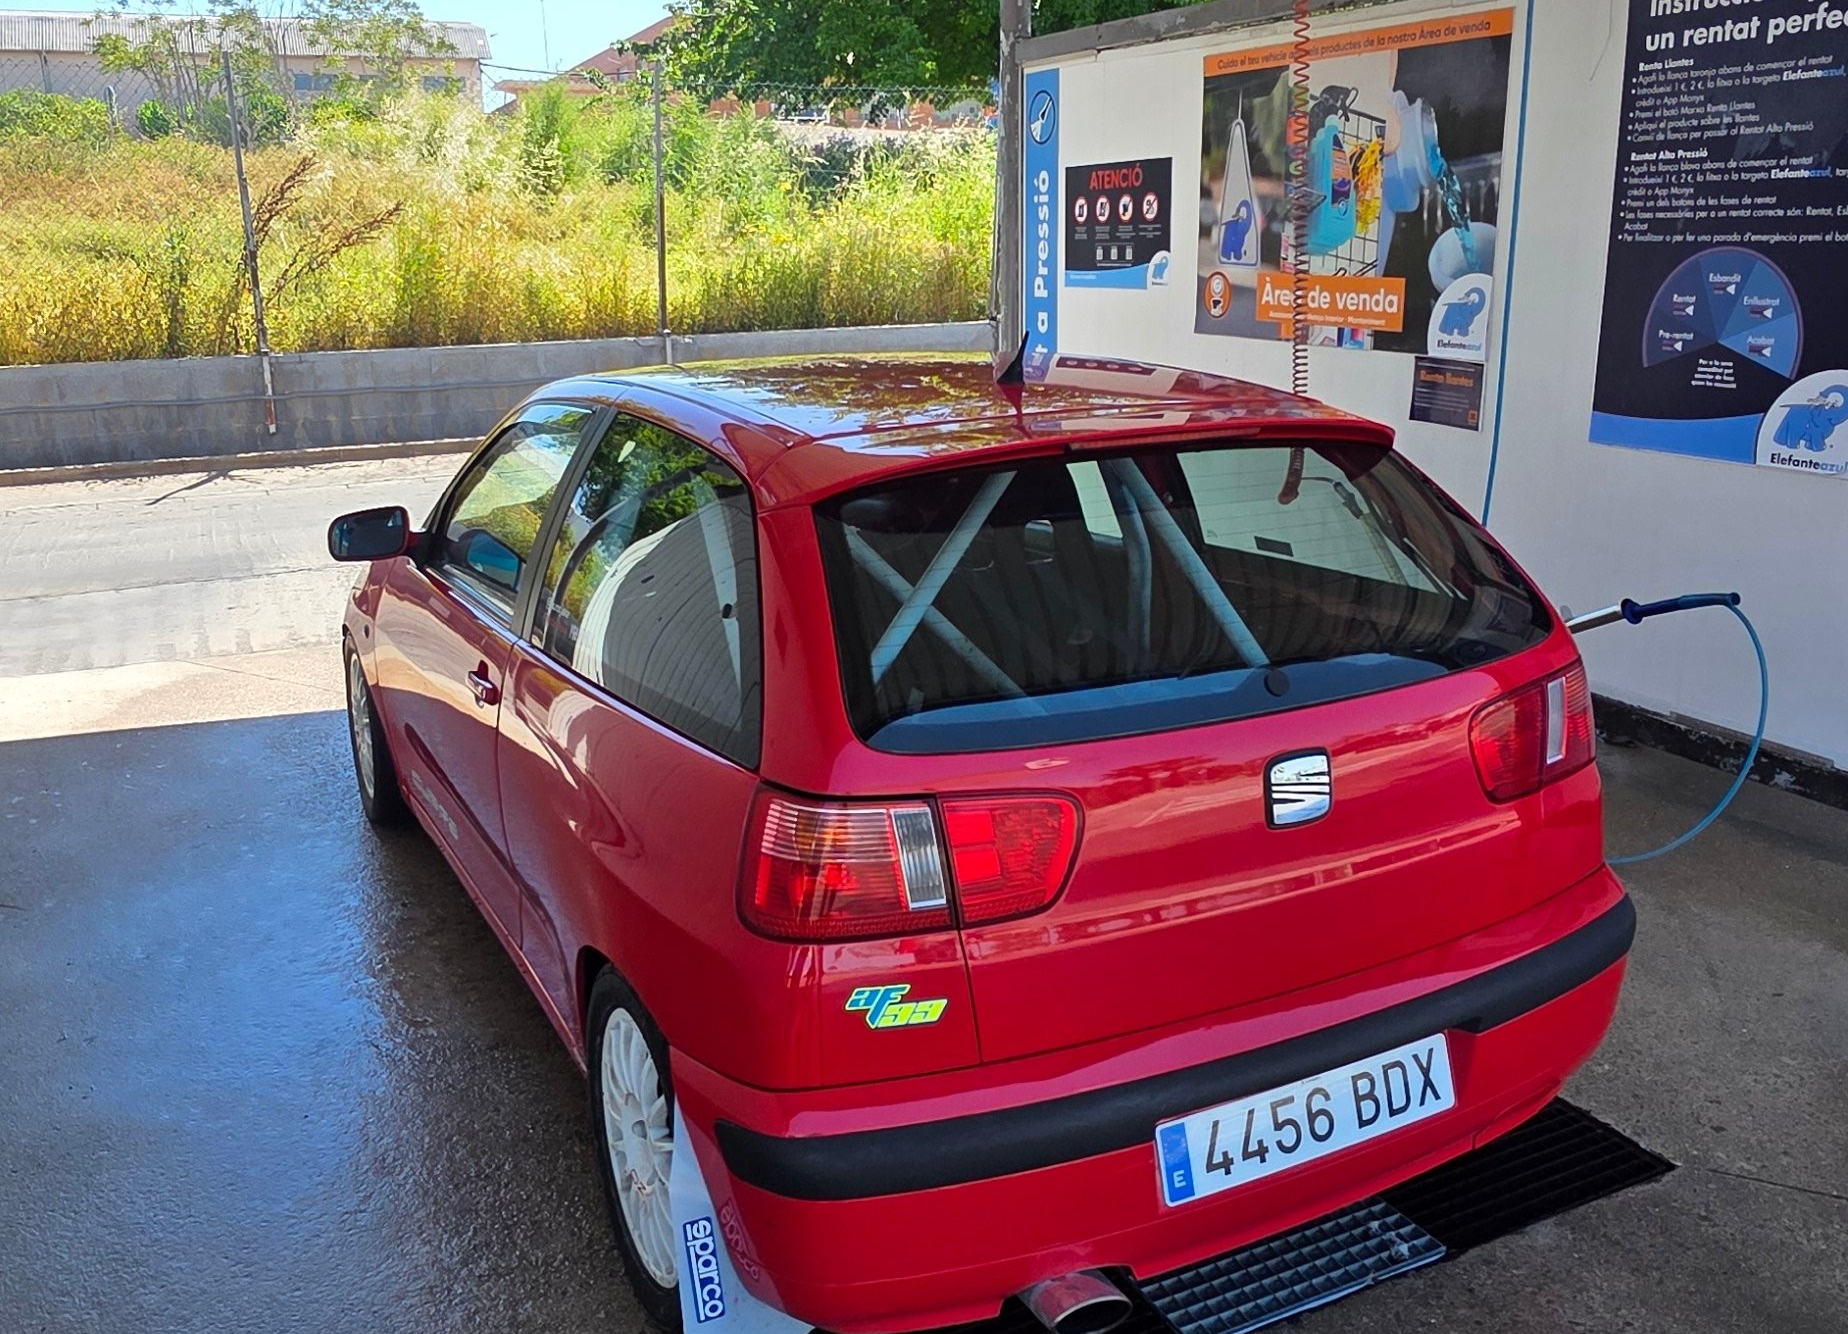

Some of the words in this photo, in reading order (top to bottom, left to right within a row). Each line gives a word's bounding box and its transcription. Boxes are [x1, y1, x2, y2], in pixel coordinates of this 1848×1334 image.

[1320, 40, 1361, 58] productes
[1363, 37, 1375, 48] de
[1376, 35, 1386, 46] la
[1387, 31, 1417, 45] nostra
[1443, 24, 1457, 36] de
[1459, 20, 1491, 34] venda
[1645, 31, 1675, 51] un
[1682, 15, 1761, 48] rentat
[1639, 61, 1663, 72] Renta
[1664, 58, 1694, 68] Llantes
[1658, 71, 1665, 81] la
[1718, 65, 1741, 75] abans
[1743, 62, 1754, 72] de
[1798, 56, 1807, 66] el
[1808, 55, 1833, 65] rentat
[1674, 82, 1678, 91] 1
[1690, 80, 1696, 90] 2
[1706, 78, 1715, 88] la
[1742, 75, 1750, 85] la
[1752, 74, 1780, 86] targeta
[1655, 108, 1661, 117] el
[1706, 103, 1728, 113] Renta
[1729, 100, 1756, 111] Llantes
[1663, 96, 1678, 106] App
[1659, 119, 1666, 128] el
[1667, 117, 1699, 129] producte
[1700, 115, 1721, 126] sobre
[1656, 131, 1665, 141] de
[1689, 131, 1702, 141] per
[1730, 125, 1738, 136] al
[1739, 125, 1765, 135] Rentat
[1765, 122, 1783, 133] Alta
[1784, 120, 1814, 132] Pressió
[1630, 152, 1657, 161] Rentat
[1658, 149, 1676, 160] Alta
[1677, 147, 1708, 159] Pressió
[1649, 162, 1657, 172] la
[1680, 160, 1701, 171] blava
[1702, 159, 1725, 169] abans
[1727, 158, 1737, 168] de
[1779, 155, 1788, 166] el
[1789, 156, 1814, 166] rentat
[1089, 163, 1143, 191] ATENCIÓ
[1665, 173, 1670, 183] 1
[1680, 173, 1686, 183] 2
[1696, 172, 1704, 182] la
[1731, 170, 1739, 180] la
[1740, 171, 1769, 182] targeta
[1653, 186, 1669, 197] App
[1656, 198, 1670, 207] dels
[1671, 197, 1695, 207] botons
[1696, 196, 1706, 206] de
[1708, 195, 1719, 205] les
[1720, 195, 1739, 205] fases
[1741, 194, 1752, 205] de
[1753, 195, 1777, 204] rentat
[1637, 209, 1654, 219] fases
[1695, 210, 1708, 220] per
[1717, 210, 1727, 218] un
[1728, 208, 1752, 217] rentat
[1752, 208, 1784, 217] correcte
[1836, 204, 1848, 216] Es
[1624, 221, 1648, 230] Acabat
[1033, 170, 1049, 299] Pressió
[1623, 233, 1633, 242] Per
[1671, 234, 1684, 244] per
[1686, 231, 1695, 242] fer
[1697, 234, 1711, 242] una
[1712, 231, 1741, 244] parada
[1799, 232, 1823, 244] premi
[1824, 230, 1833, 242] el
[1709, 273, 1741, 283] Esbandit
[1307, 285, 1330, 309] de
[1335, 288, 1399, 314] venda
[1672, 293, 1697, 304] Rentat
[1037, 311, 1049, 333] a
[1658, 329, 1694, 341] Pre-rentat
[1173, 1170, 1187, 1188] E
[1205, 1087, 1335, 1176] 4456
[1350, 1047, 1442, 1130] BDX
[687, 1219, 725, 1320] sparco
